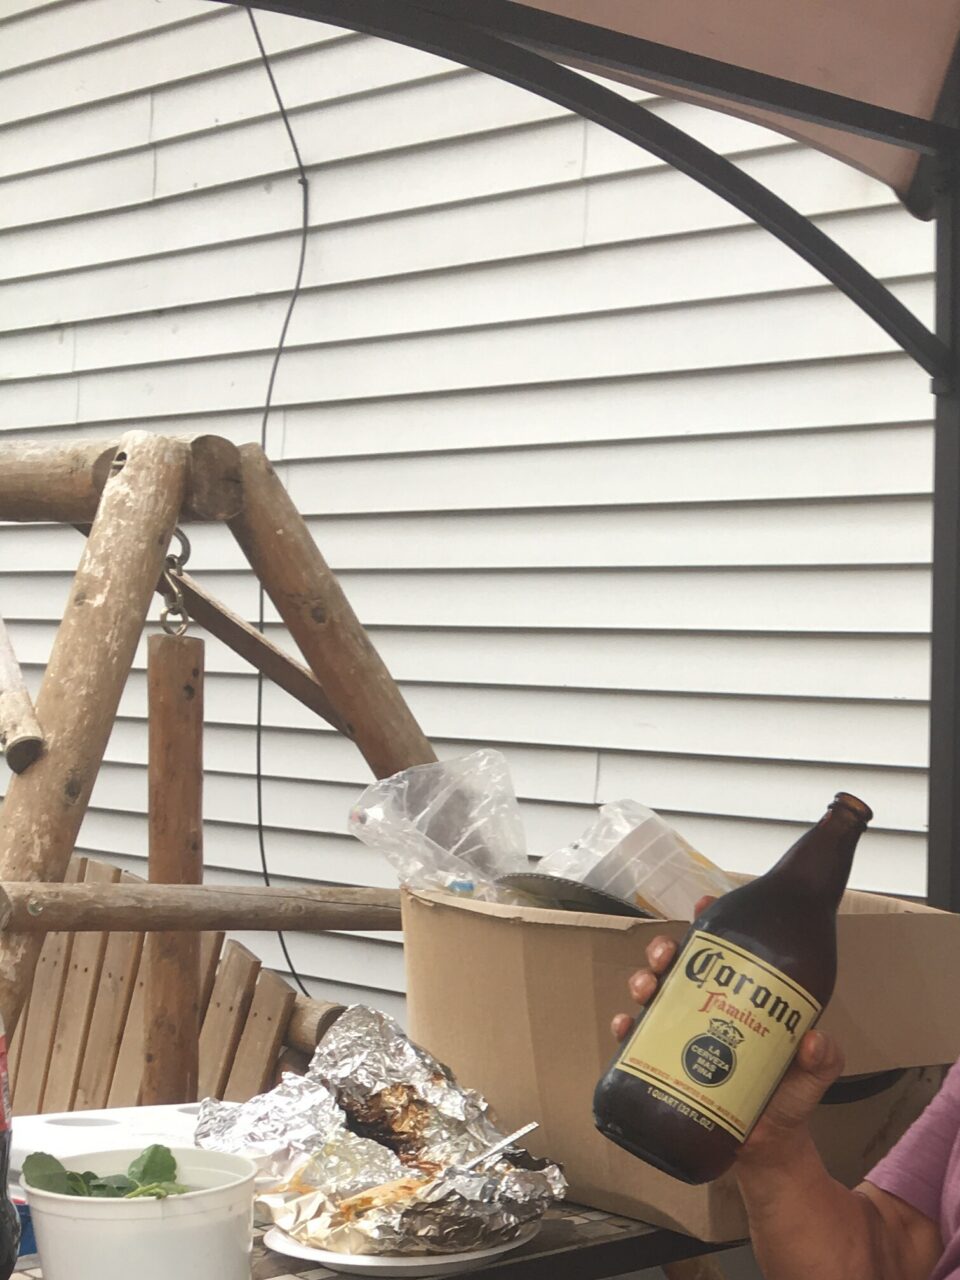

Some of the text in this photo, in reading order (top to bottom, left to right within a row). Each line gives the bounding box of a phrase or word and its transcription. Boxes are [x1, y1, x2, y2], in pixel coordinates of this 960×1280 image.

[685, 948, 802, 1035] Corona
[698, 990, 770, 1037] Familiar
[691, 1044, 729, 1071] CERVEZA
[708, 1045, 721, 1058] LA
[692, 1064, 712, 1080] FINA
[652, 1089, 679, 1109] QUART
